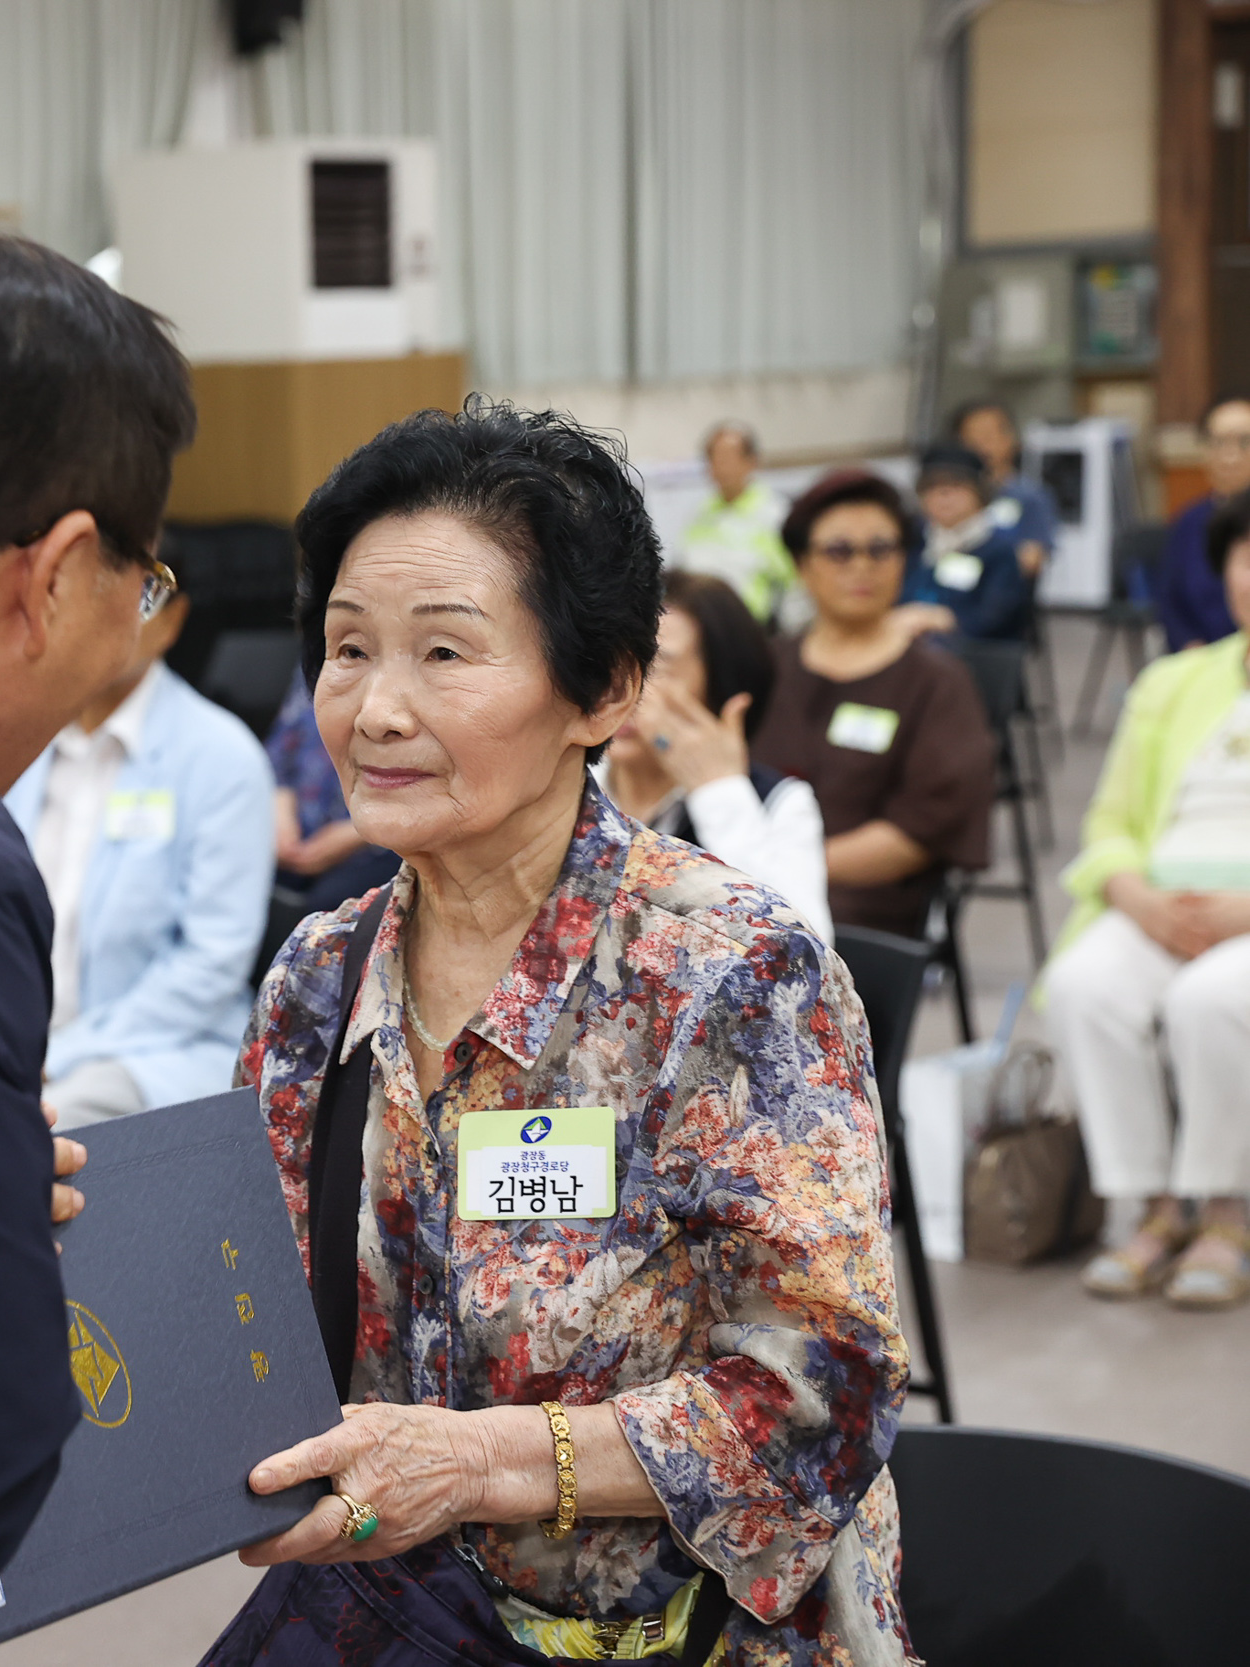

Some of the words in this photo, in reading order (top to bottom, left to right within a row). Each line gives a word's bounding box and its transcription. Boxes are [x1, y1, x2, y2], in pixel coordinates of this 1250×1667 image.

[520, 1150, 546, 1161] 광장동
[500, 1161, 570, 1174] 광장청구경로당
[488, 1175, 584, 1214] 김병남
